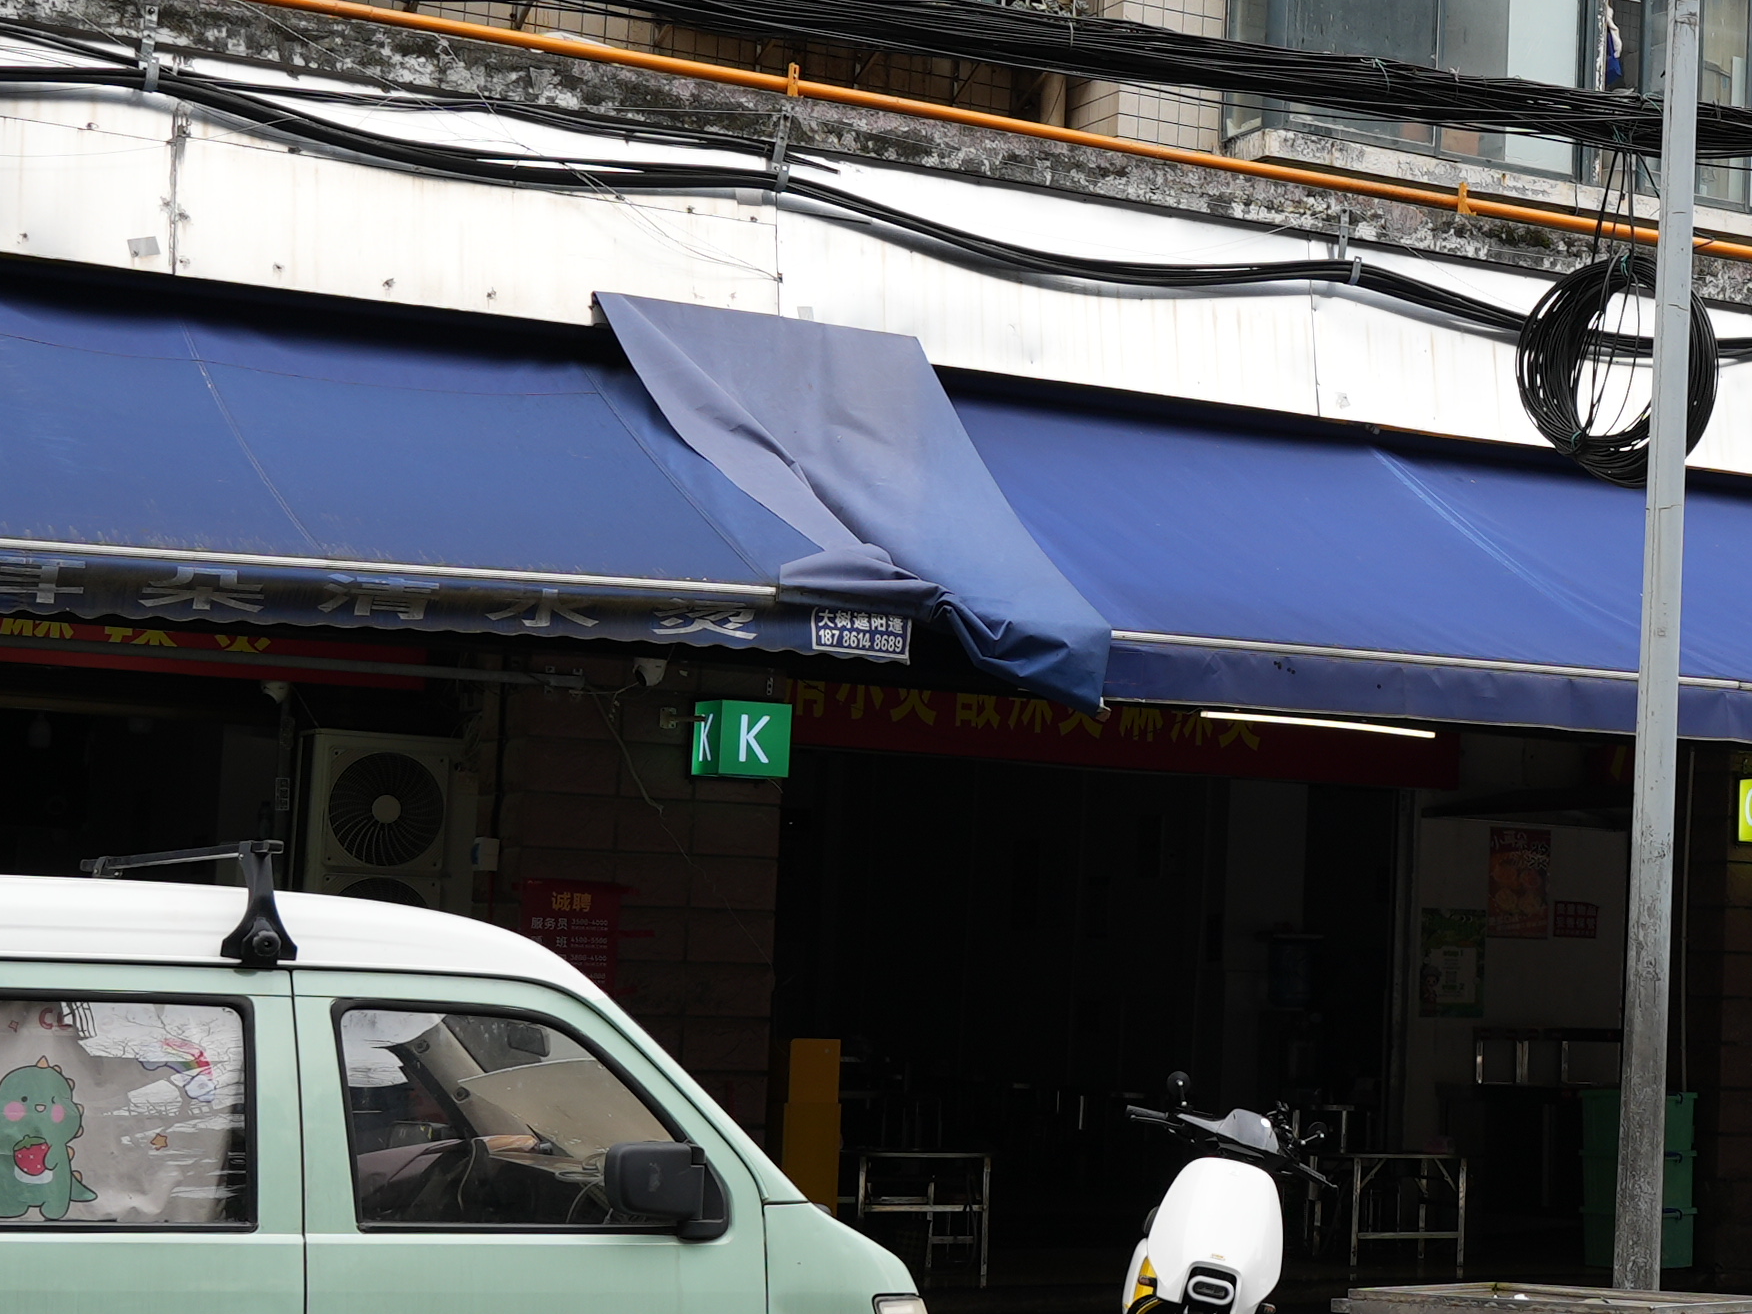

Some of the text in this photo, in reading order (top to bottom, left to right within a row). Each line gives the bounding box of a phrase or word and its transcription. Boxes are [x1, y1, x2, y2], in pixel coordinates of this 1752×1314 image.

[819, 629, 903, 652] 187 8614 8689
[739, 714, 771, 765] K
[552, 892, 592, 912] 诚聘
[531, 917, 568, 930] 服务员
